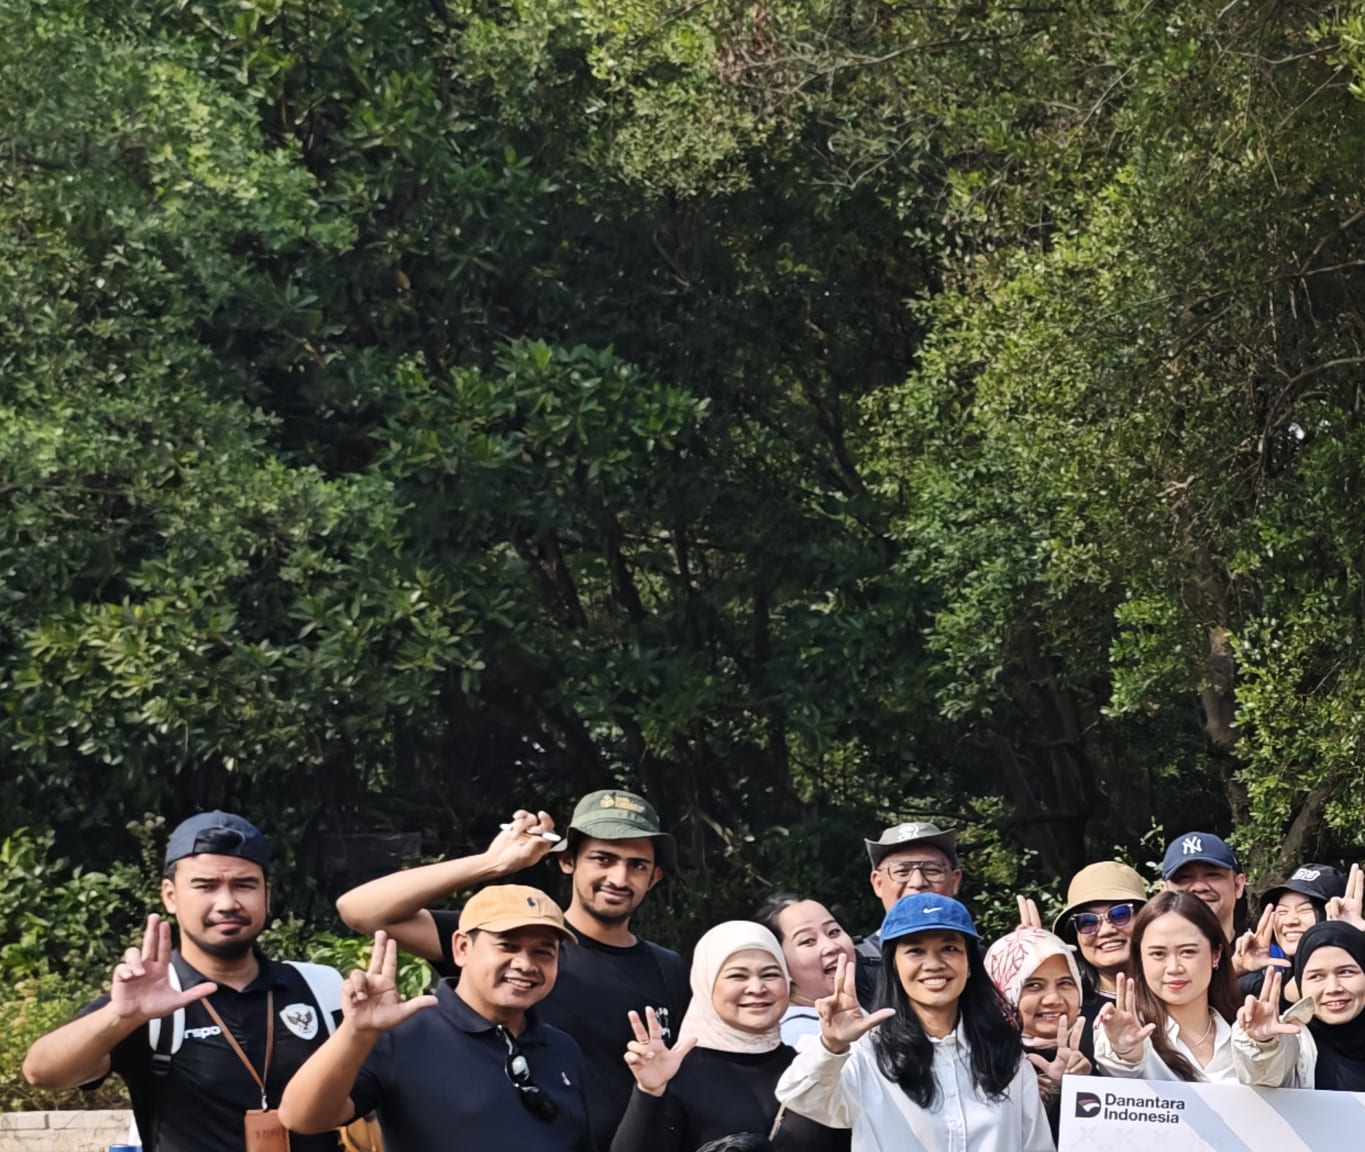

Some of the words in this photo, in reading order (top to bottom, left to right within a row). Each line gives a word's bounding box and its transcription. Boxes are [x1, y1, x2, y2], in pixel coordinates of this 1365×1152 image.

[184, 1025, 221, 1039] rspo
[1104, 1093, 1185, 1110] Danantara
[1104, 1108, 1180, 1124] Indonesia
